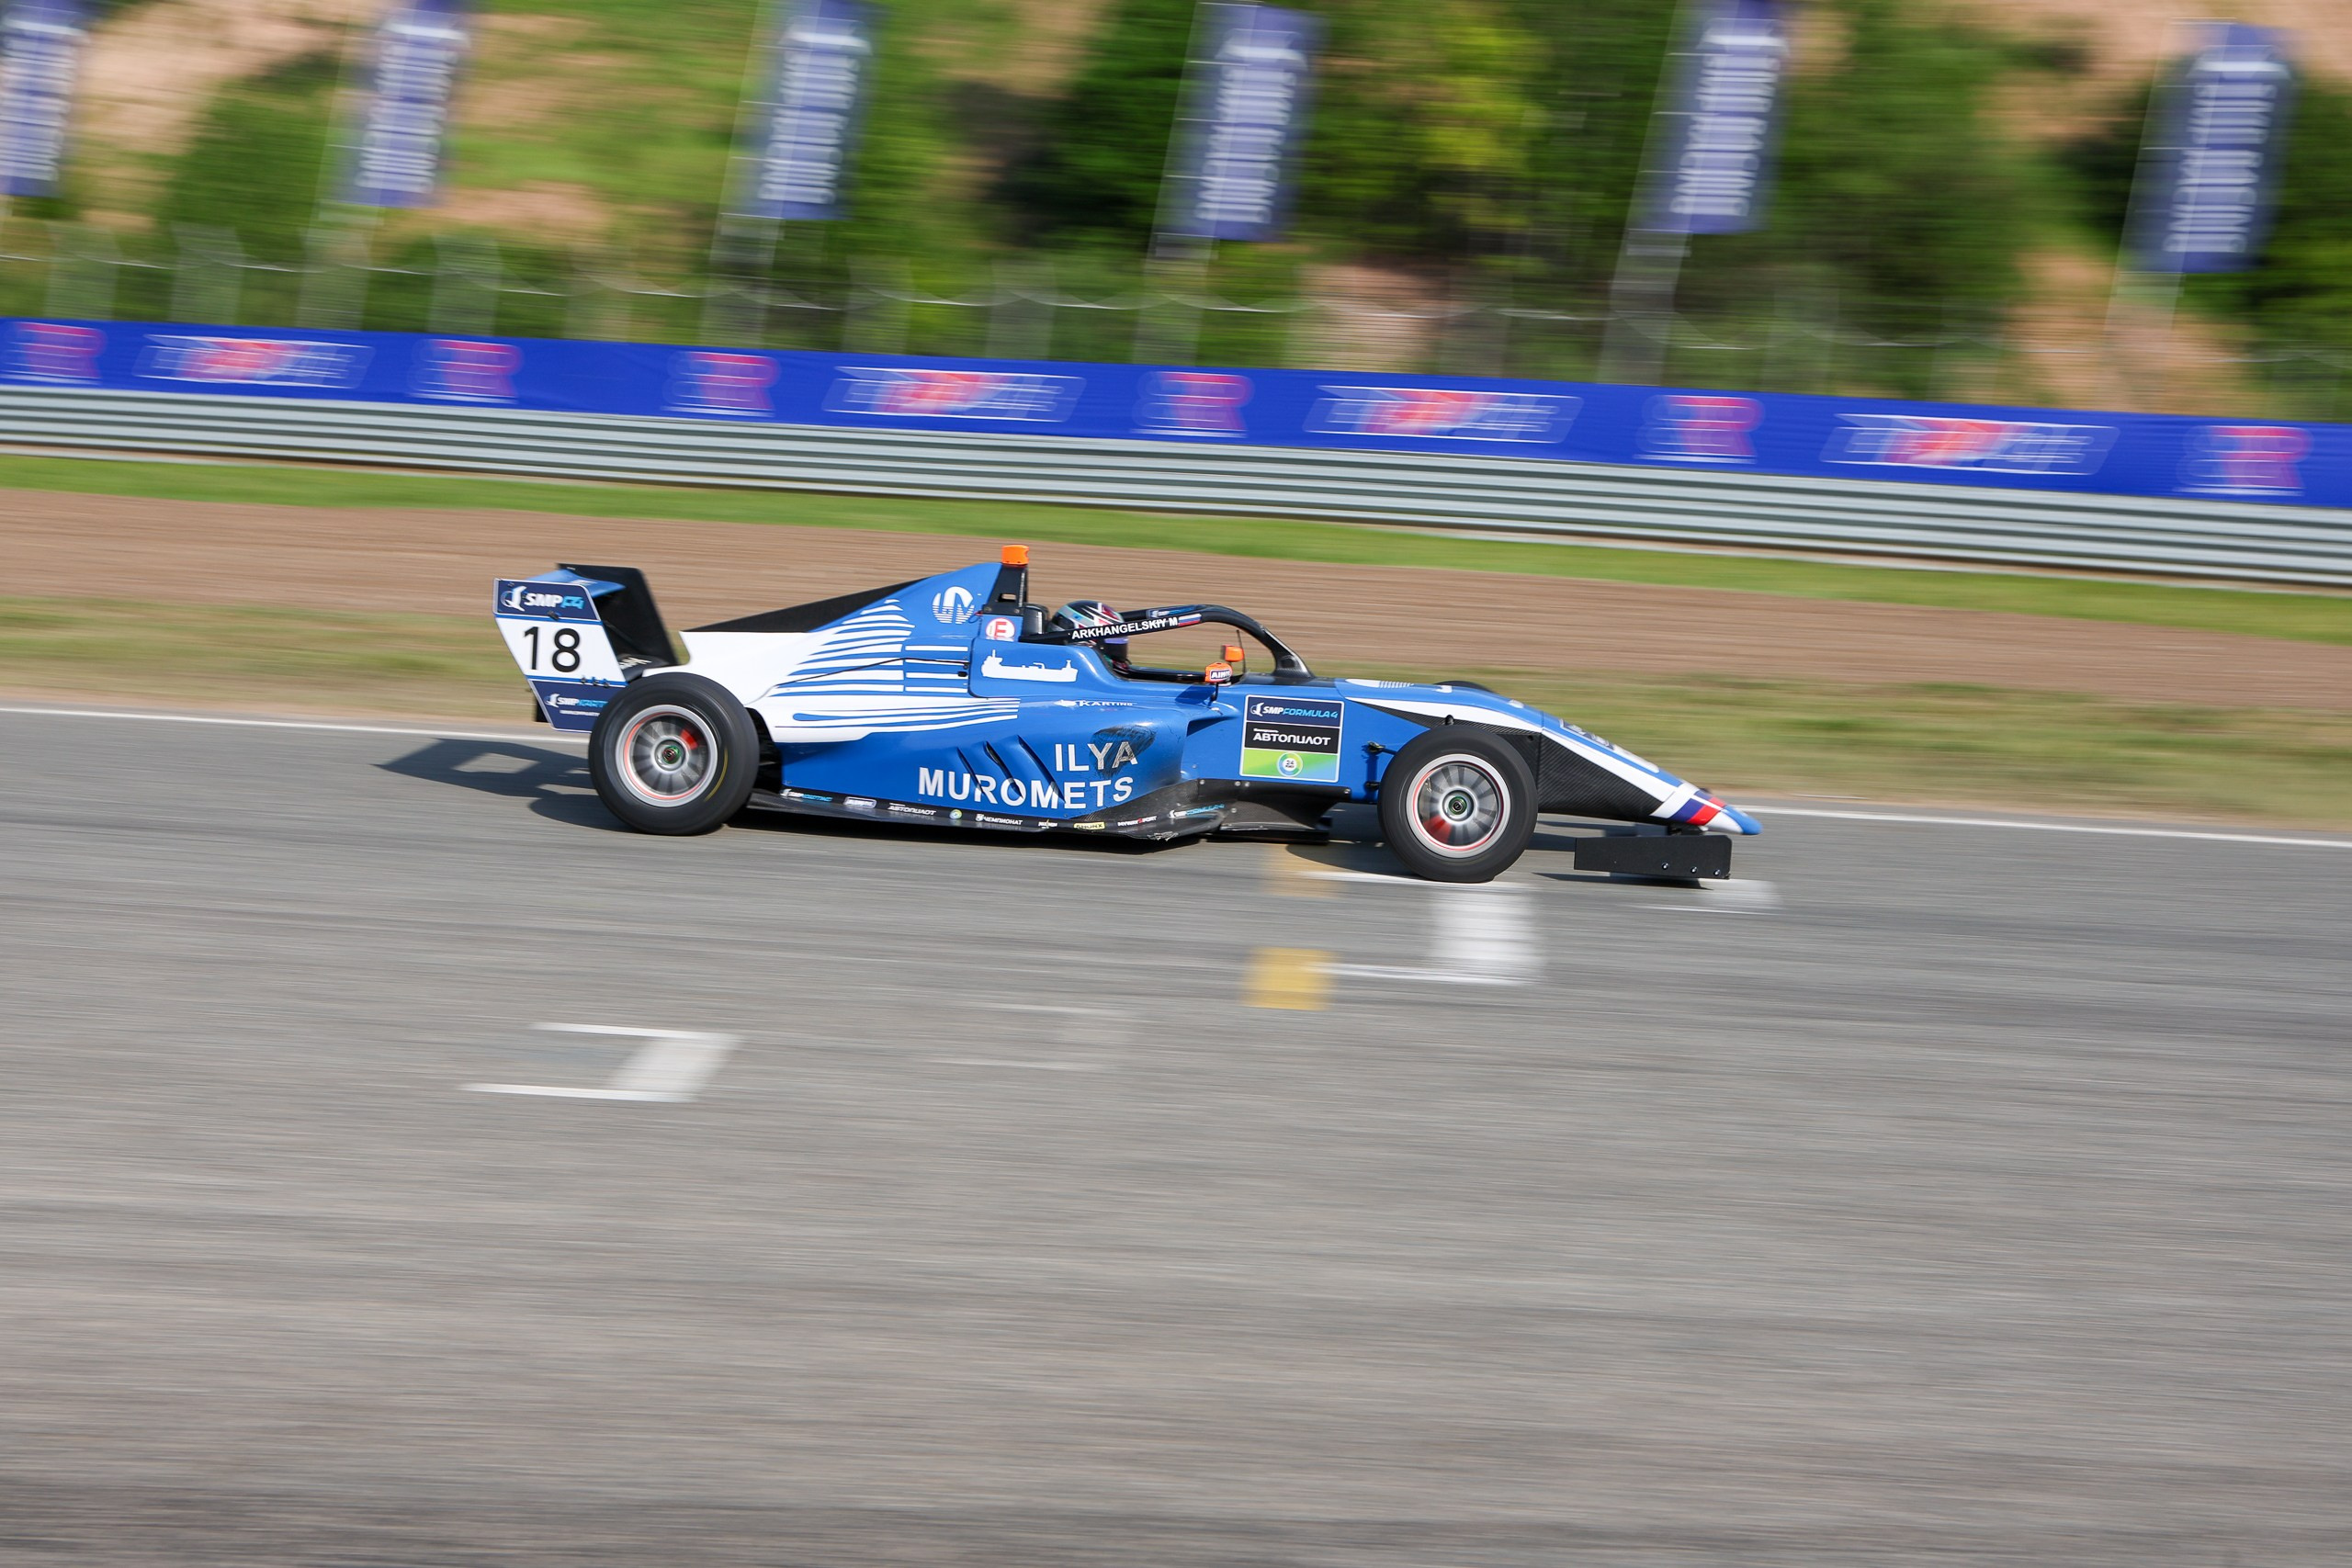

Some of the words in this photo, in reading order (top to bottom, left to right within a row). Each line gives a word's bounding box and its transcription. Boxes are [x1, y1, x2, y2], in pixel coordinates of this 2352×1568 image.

[1071, 618, 1167, 639] ARKHANGELSKIY
[523, 626, 581, 673] 18
[1252, 732, 1331, 746] АВТОПИЛОТ
[1055, 741, 1138, 772] ILYA
[919, 766, 1134, 809] MUROMETS
